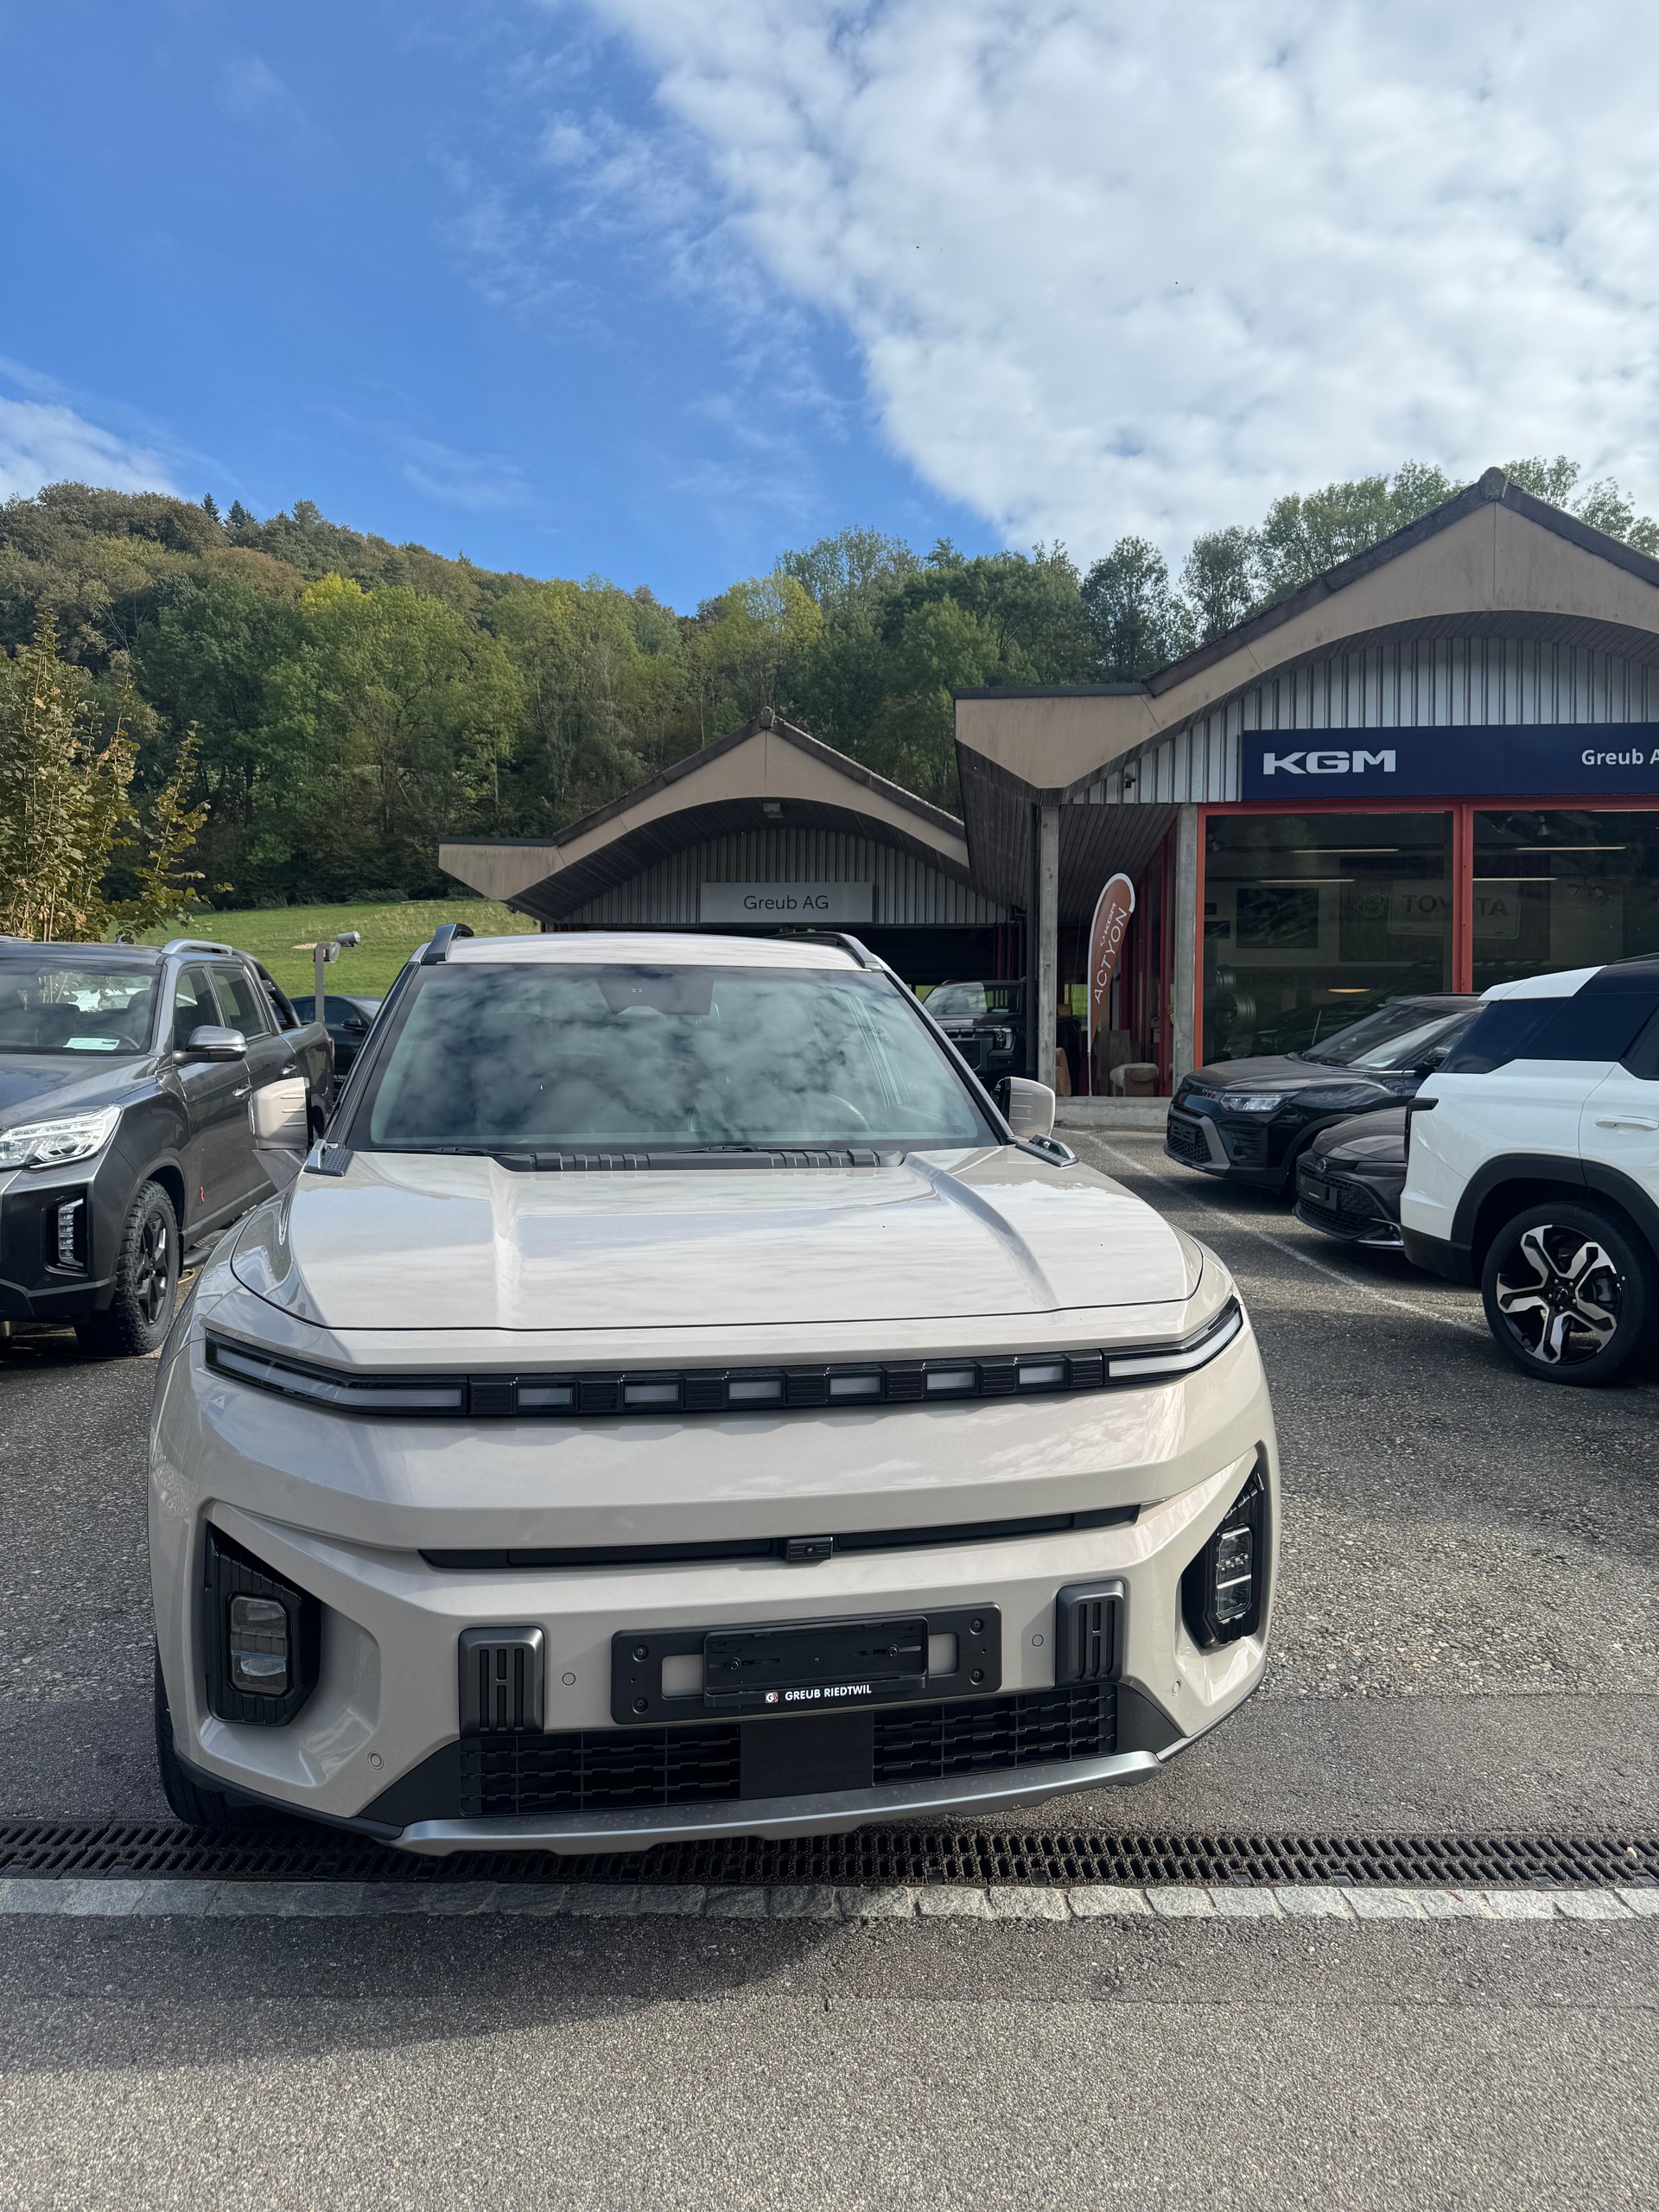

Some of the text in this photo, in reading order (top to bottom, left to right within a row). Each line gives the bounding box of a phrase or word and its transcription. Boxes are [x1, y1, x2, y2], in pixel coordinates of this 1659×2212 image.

[1262, 749, 1396, 775] KGM
[1581, 748, 1644, 766] Greub
[743, 894, 829, 910] Greub AG
[1401, 893, 1509, 917] TOTA
[1104, 902, 1116, 935] KGM
[1094, 906, 1128, 1004] ACTYON
[785, 1688, 821, 1700] GREUB
[823, 1684, 872, 1698] RIEDTWIL
